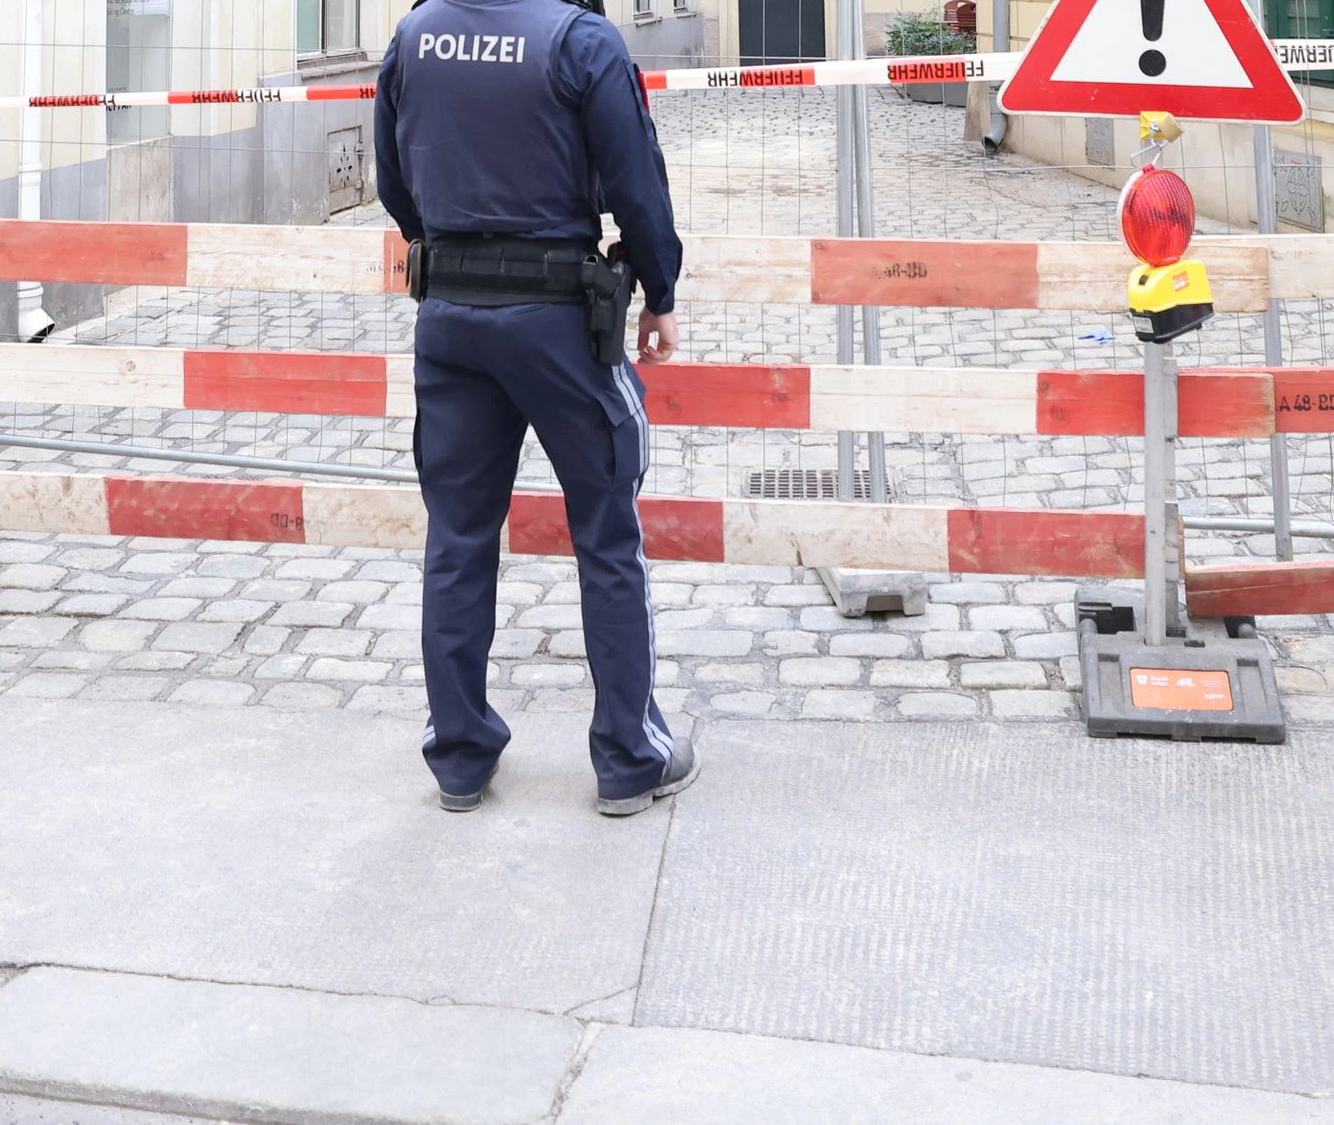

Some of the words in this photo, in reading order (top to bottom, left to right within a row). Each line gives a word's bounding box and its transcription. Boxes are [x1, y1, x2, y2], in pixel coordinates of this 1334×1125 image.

[418, 33, 526, 64] POLIZEI
[707, 69, 803, 88] FEUERWEHR
[887, 60, 984, 81] FEUERWEHR
